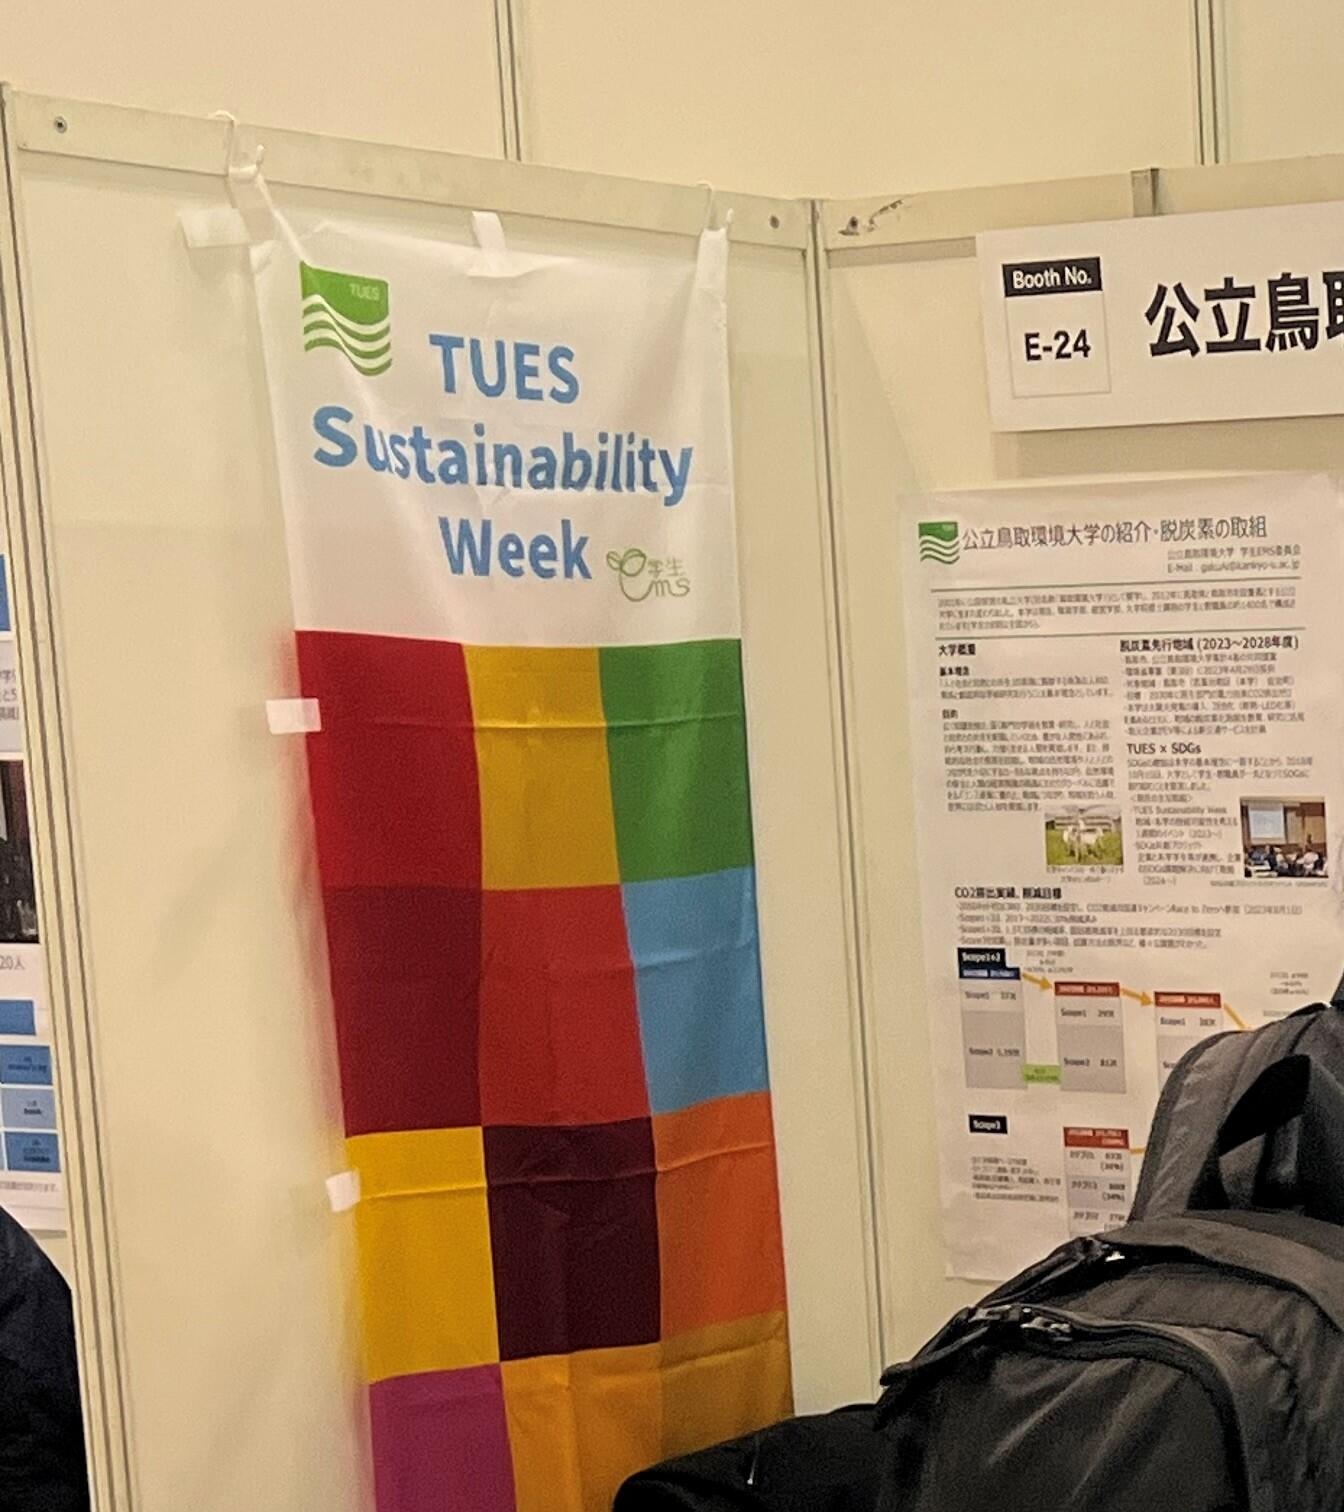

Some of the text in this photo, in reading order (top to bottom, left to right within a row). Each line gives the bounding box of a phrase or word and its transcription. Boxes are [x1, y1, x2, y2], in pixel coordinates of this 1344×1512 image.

[349, 281, 381, 303] TUES
[1012, 265, 1092, 291] Booth No.
[429, 333, 581, 405] TUES
[1024, 328, 1092, 363] E-24
[312, 404, 694, 507] Sustainability
[438, 515, 593, 581] Week
